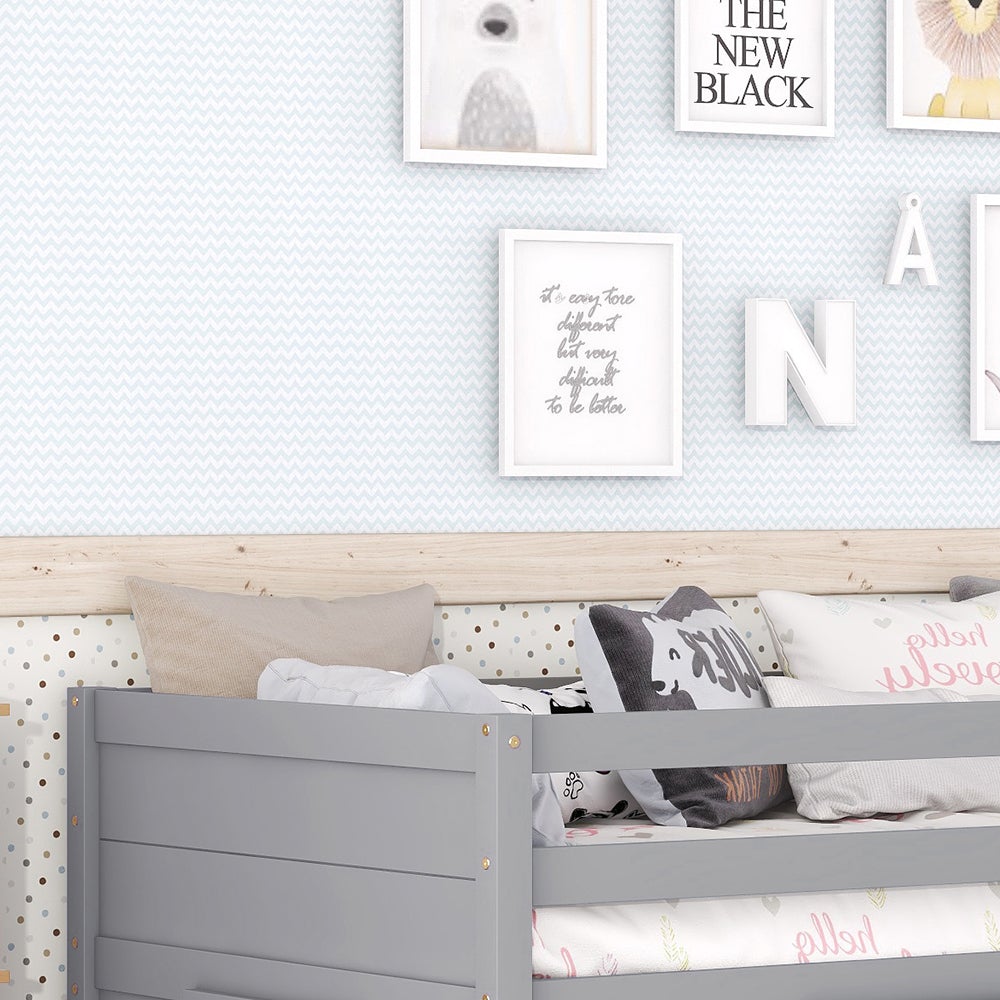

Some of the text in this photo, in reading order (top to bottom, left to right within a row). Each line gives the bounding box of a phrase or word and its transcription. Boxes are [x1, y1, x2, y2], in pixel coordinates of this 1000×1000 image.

[719, 0, 788, 30] THE
[712, 33, 794, 69] NEW
[694, 71, 814, 109] BLACK
[557, 311, 622, 343] different
[557, 337, 585, 359] but
[745, 298, 857, 426] N
[559, 366, 620, 398] difficult
[545, 395, 562, 414] to
